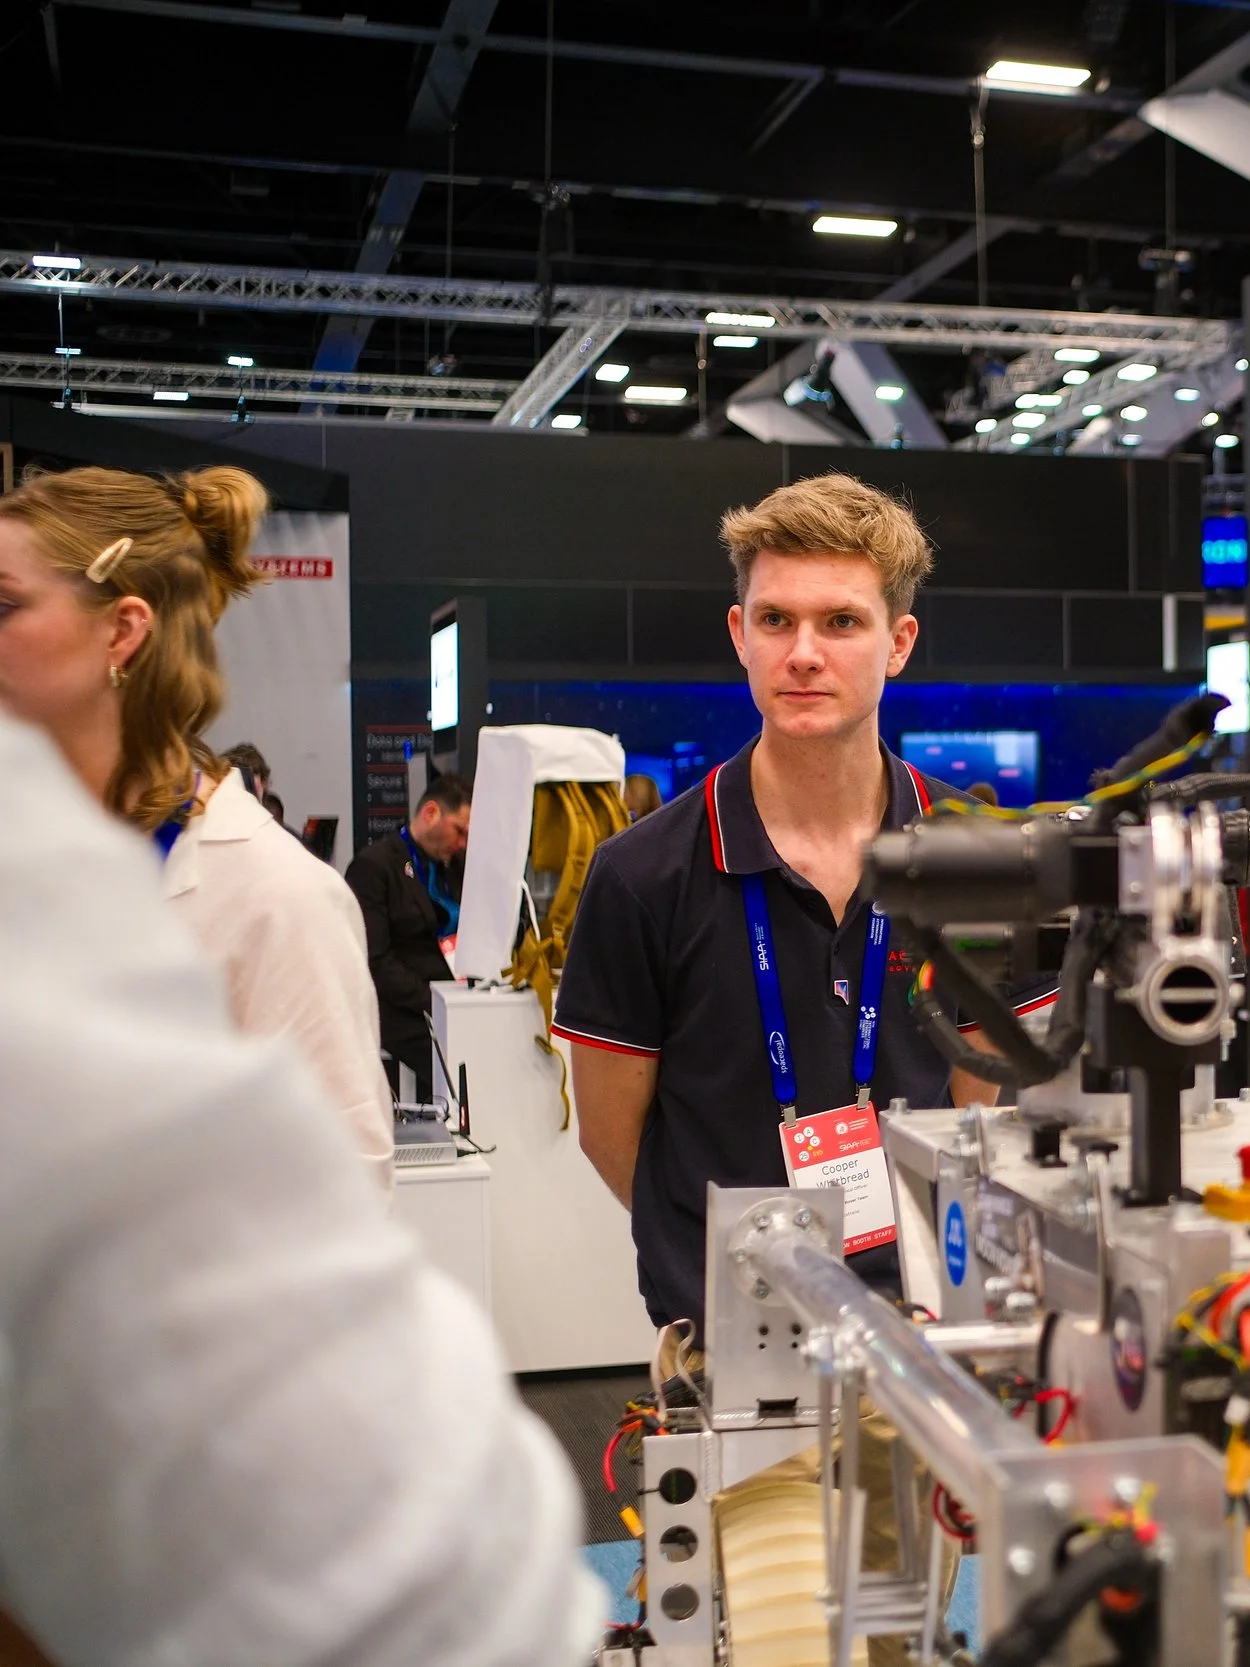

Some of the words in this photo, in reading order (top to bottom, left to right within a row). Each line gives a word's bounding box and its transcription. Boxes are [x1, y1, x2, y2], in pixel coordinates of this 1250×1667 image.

[775, 1039, 788, 1074] spaceopal
[822, 1159, 858, 1175] Cooper
[852, 1235, 872, 1246] BOOTH
[873, 1229, 893, 1240] STAFF
